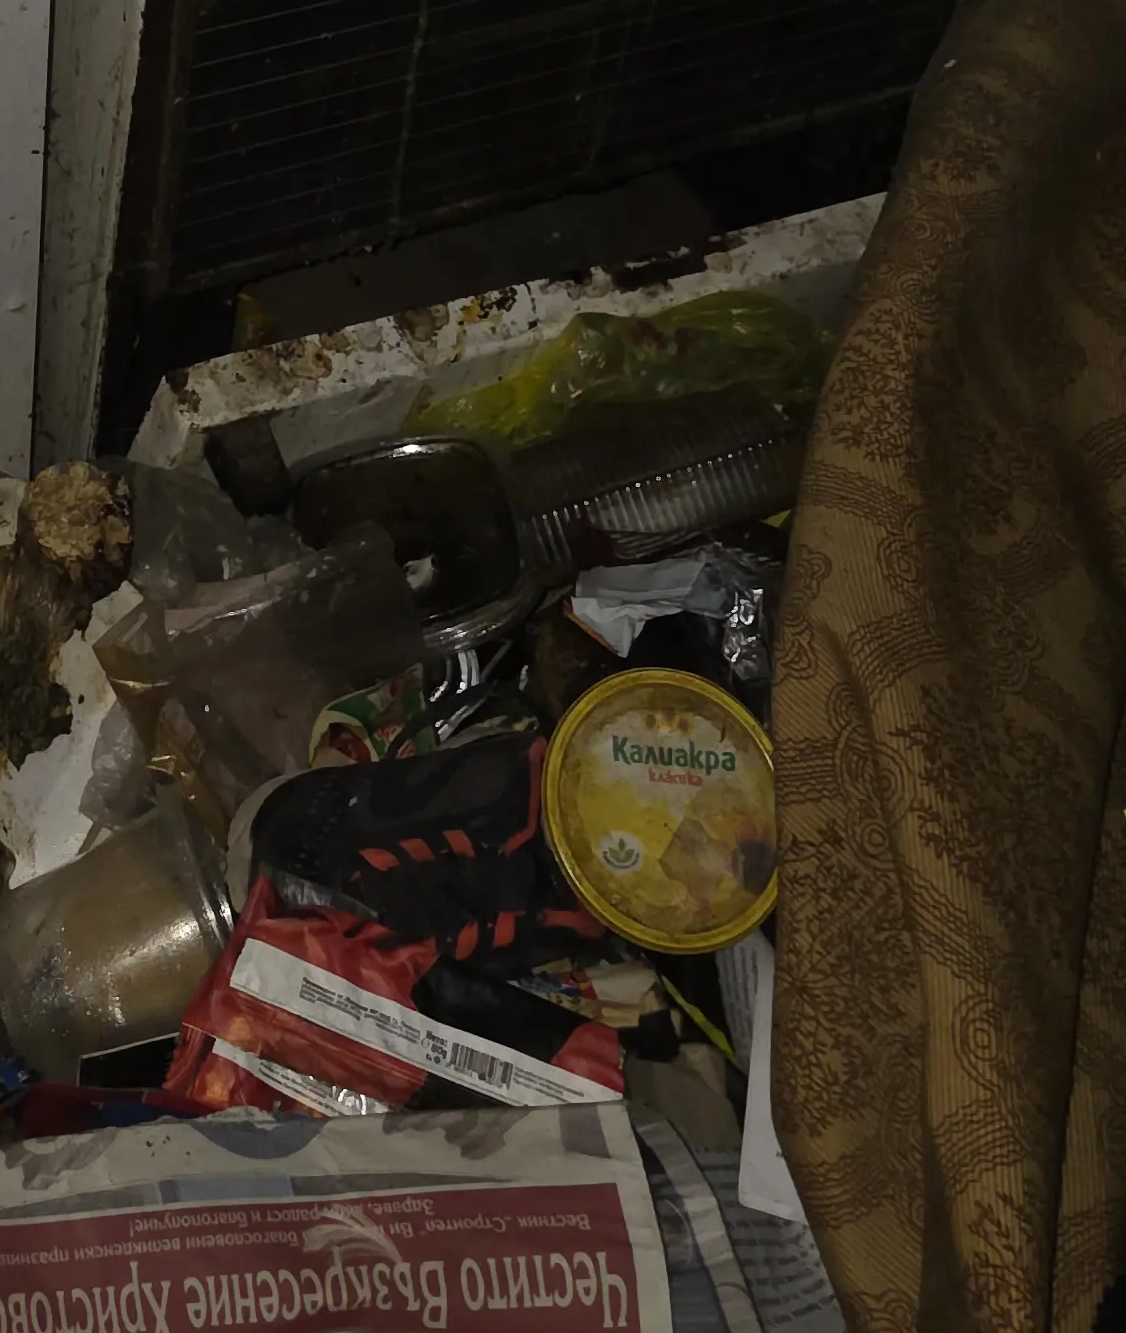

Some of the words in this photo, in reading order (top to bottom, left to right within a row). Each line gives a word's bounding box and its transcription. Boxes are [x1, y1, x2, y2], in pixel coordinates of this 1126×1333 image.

[612, 735, 736, 775] Калиакра
[129, 1209, 249, 1238] благополучие!
[252, 1212, 261, 1223] и
[519, 1213, 592, 1231] Вестник
[185, 1230, 299, 1251] благословени
[389, 1221, 414, 1239] Ви
[74, 1236, 181, 1260] великденски
[184, 1245, 448, 1330] Възкресение
[460, 1251, 628, 1329] Честито
